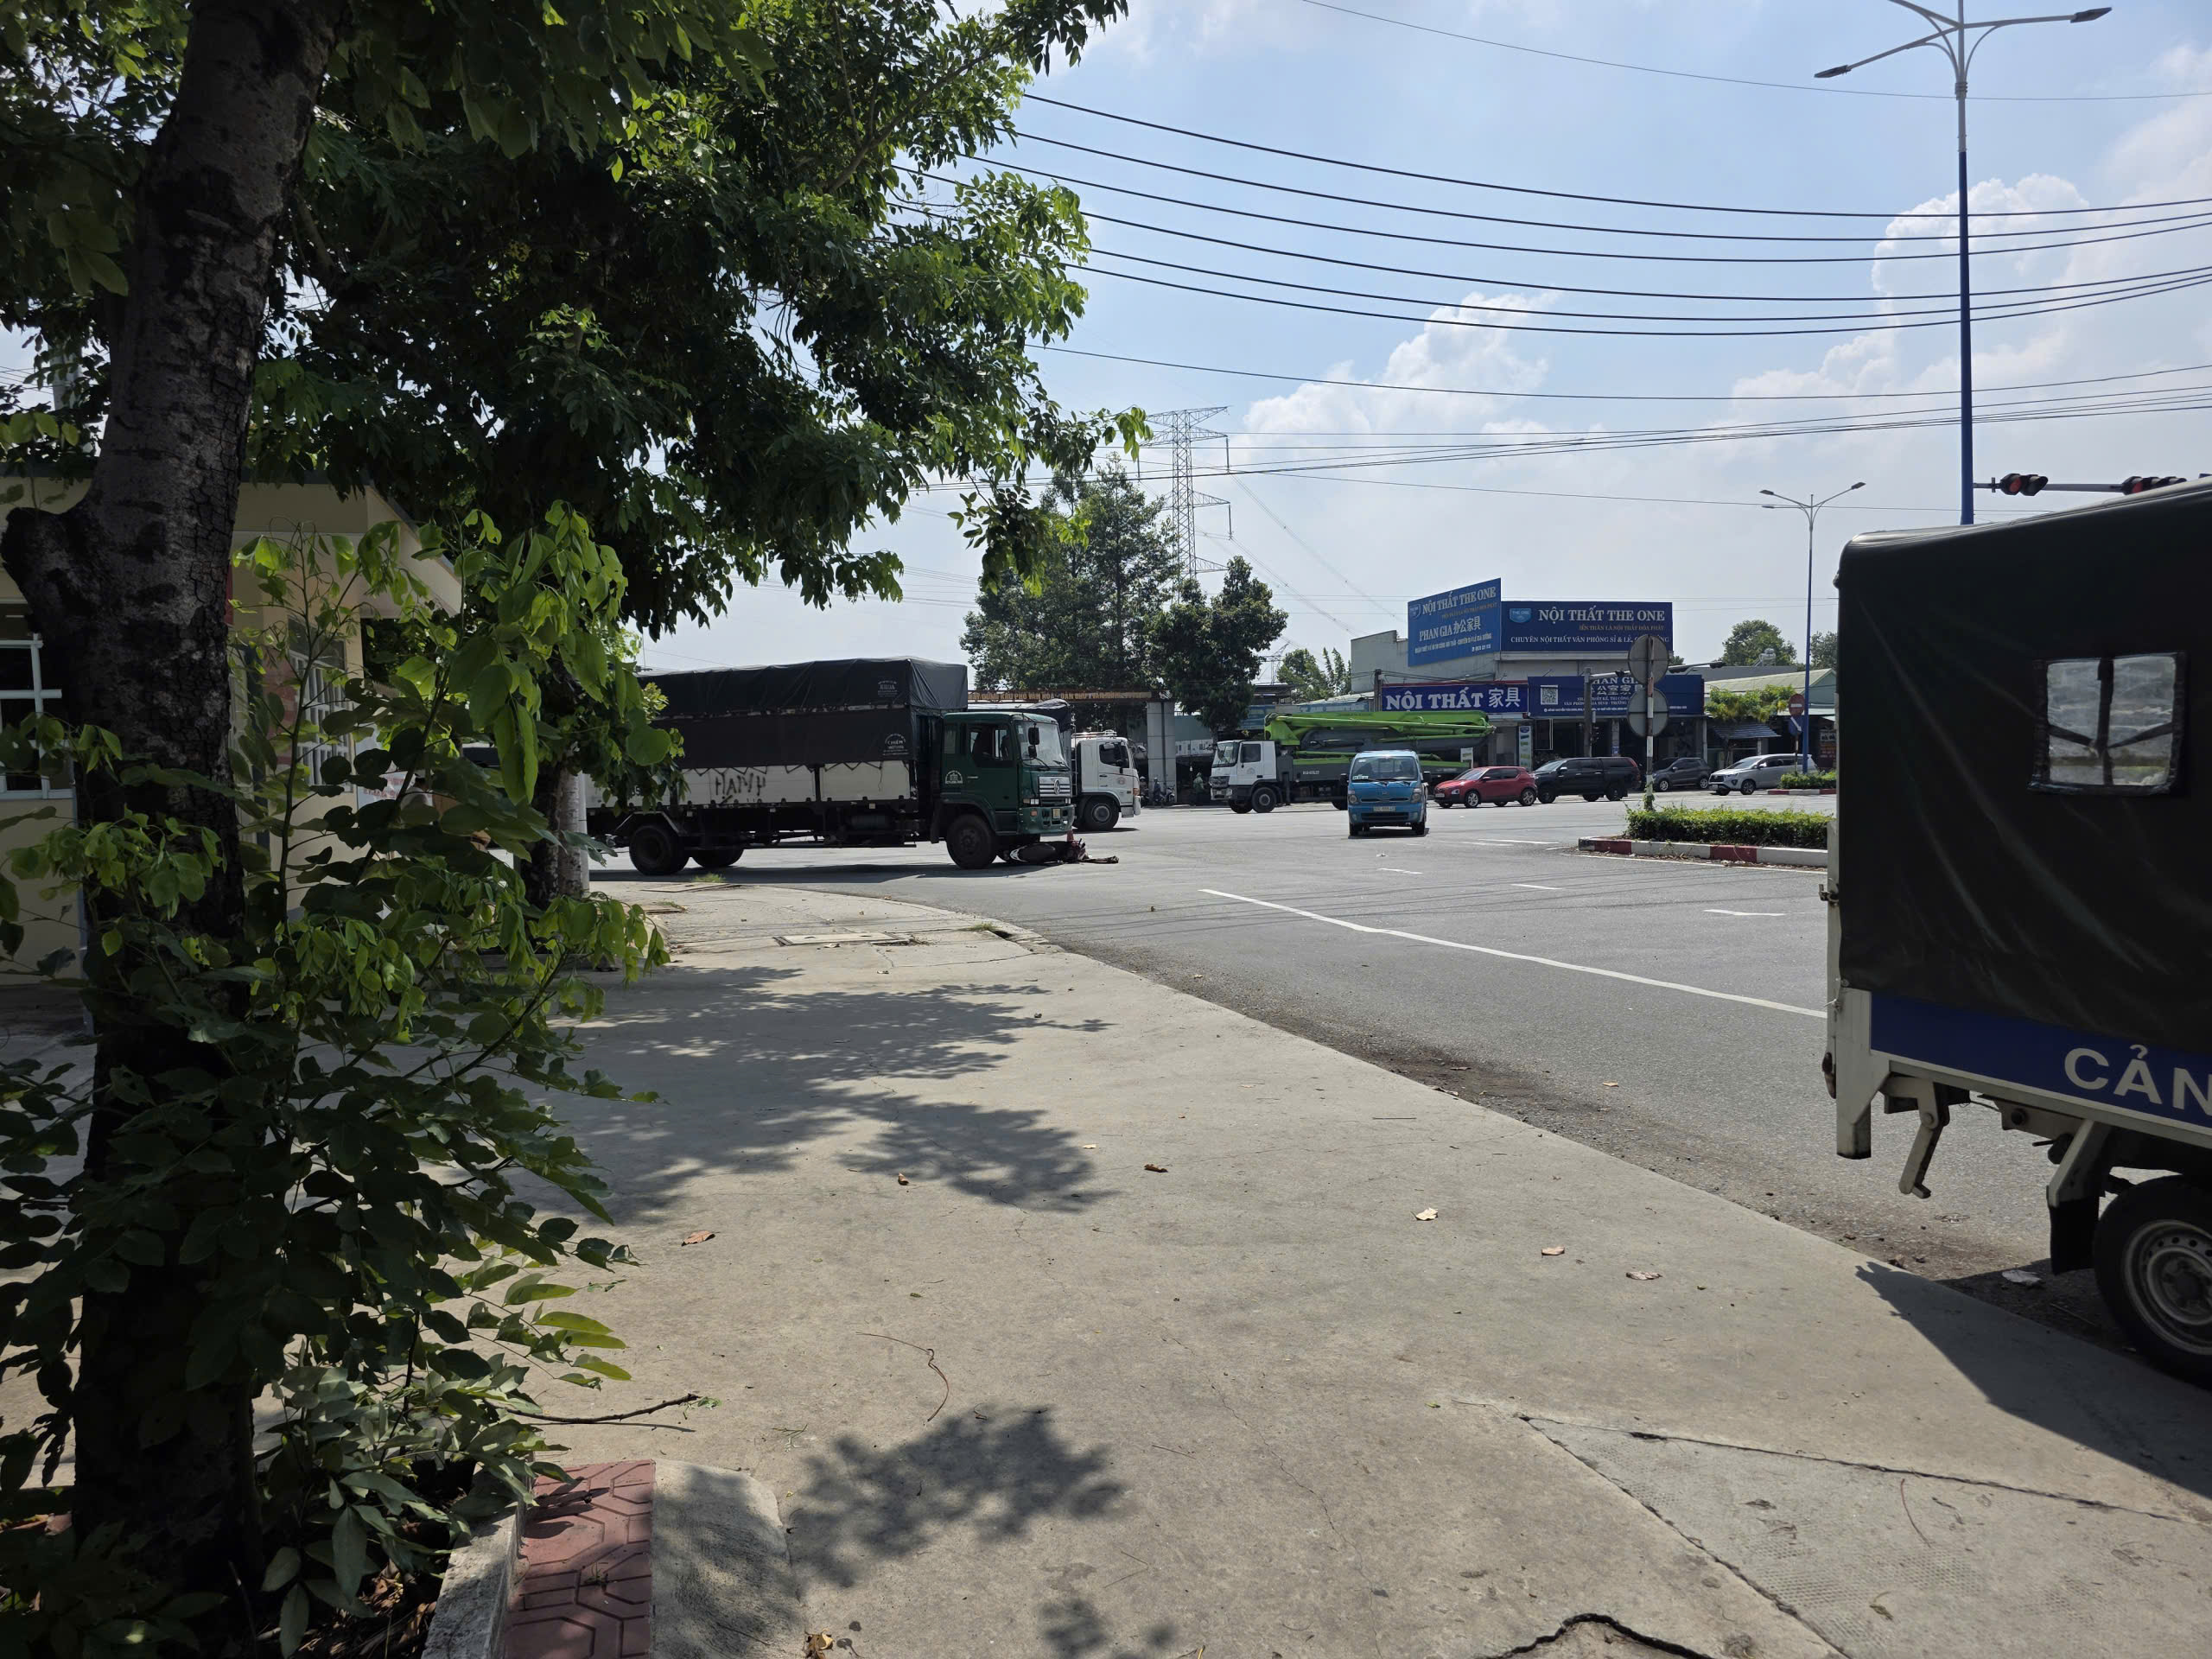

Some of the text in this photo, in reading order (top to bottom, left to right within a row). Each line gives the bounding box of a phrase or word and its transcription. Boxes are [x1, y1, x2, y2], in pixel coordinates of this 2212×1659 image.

[1422, 600, 1436, 615] NỘI
[1438, 591, 1459, 610] THẤT
[1459, 591, 1476, 605] THE
[1478, 586, 1497, 600] ONE
[1538, 605, 1665, 624] NỘI THẤT THE ONE
[1420, 625, 1453, 641] PHAN GIA
[1385, 687, 1484, 711] NỘI THẤT
[1488, 687, 1521, 709] 家具
[2064, 1044, 2212, 1117] CẢN
